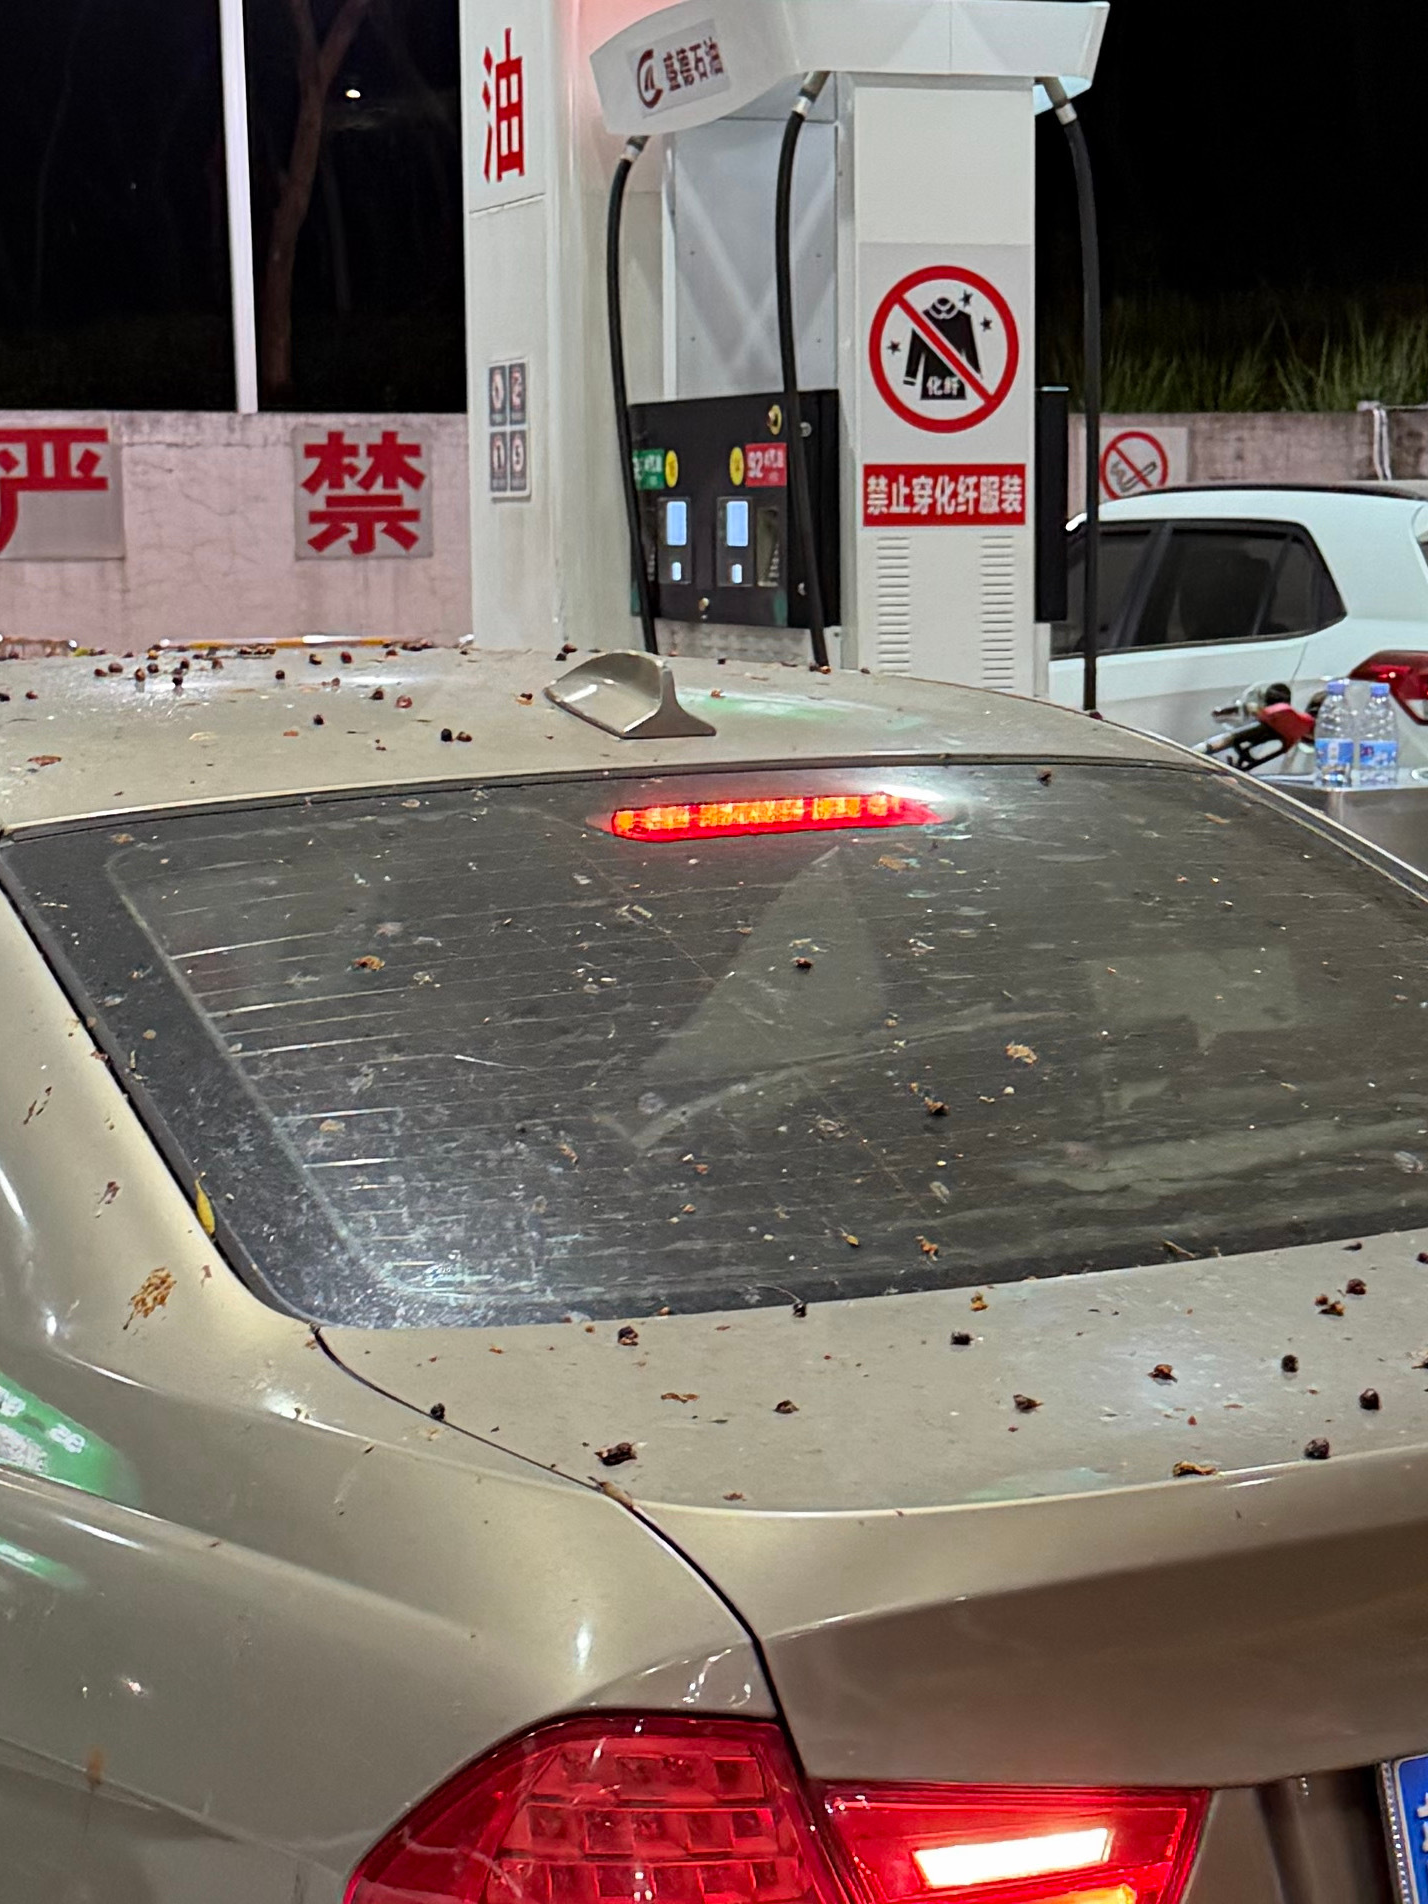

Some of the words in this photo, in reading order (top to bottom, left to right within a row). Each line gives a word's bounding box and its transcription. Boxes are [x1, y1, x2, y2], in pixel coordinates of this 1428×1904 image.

[926, 375, 960, 396] 化纤
[867, 474, 1022, 516] 禁止穿化纤服装
